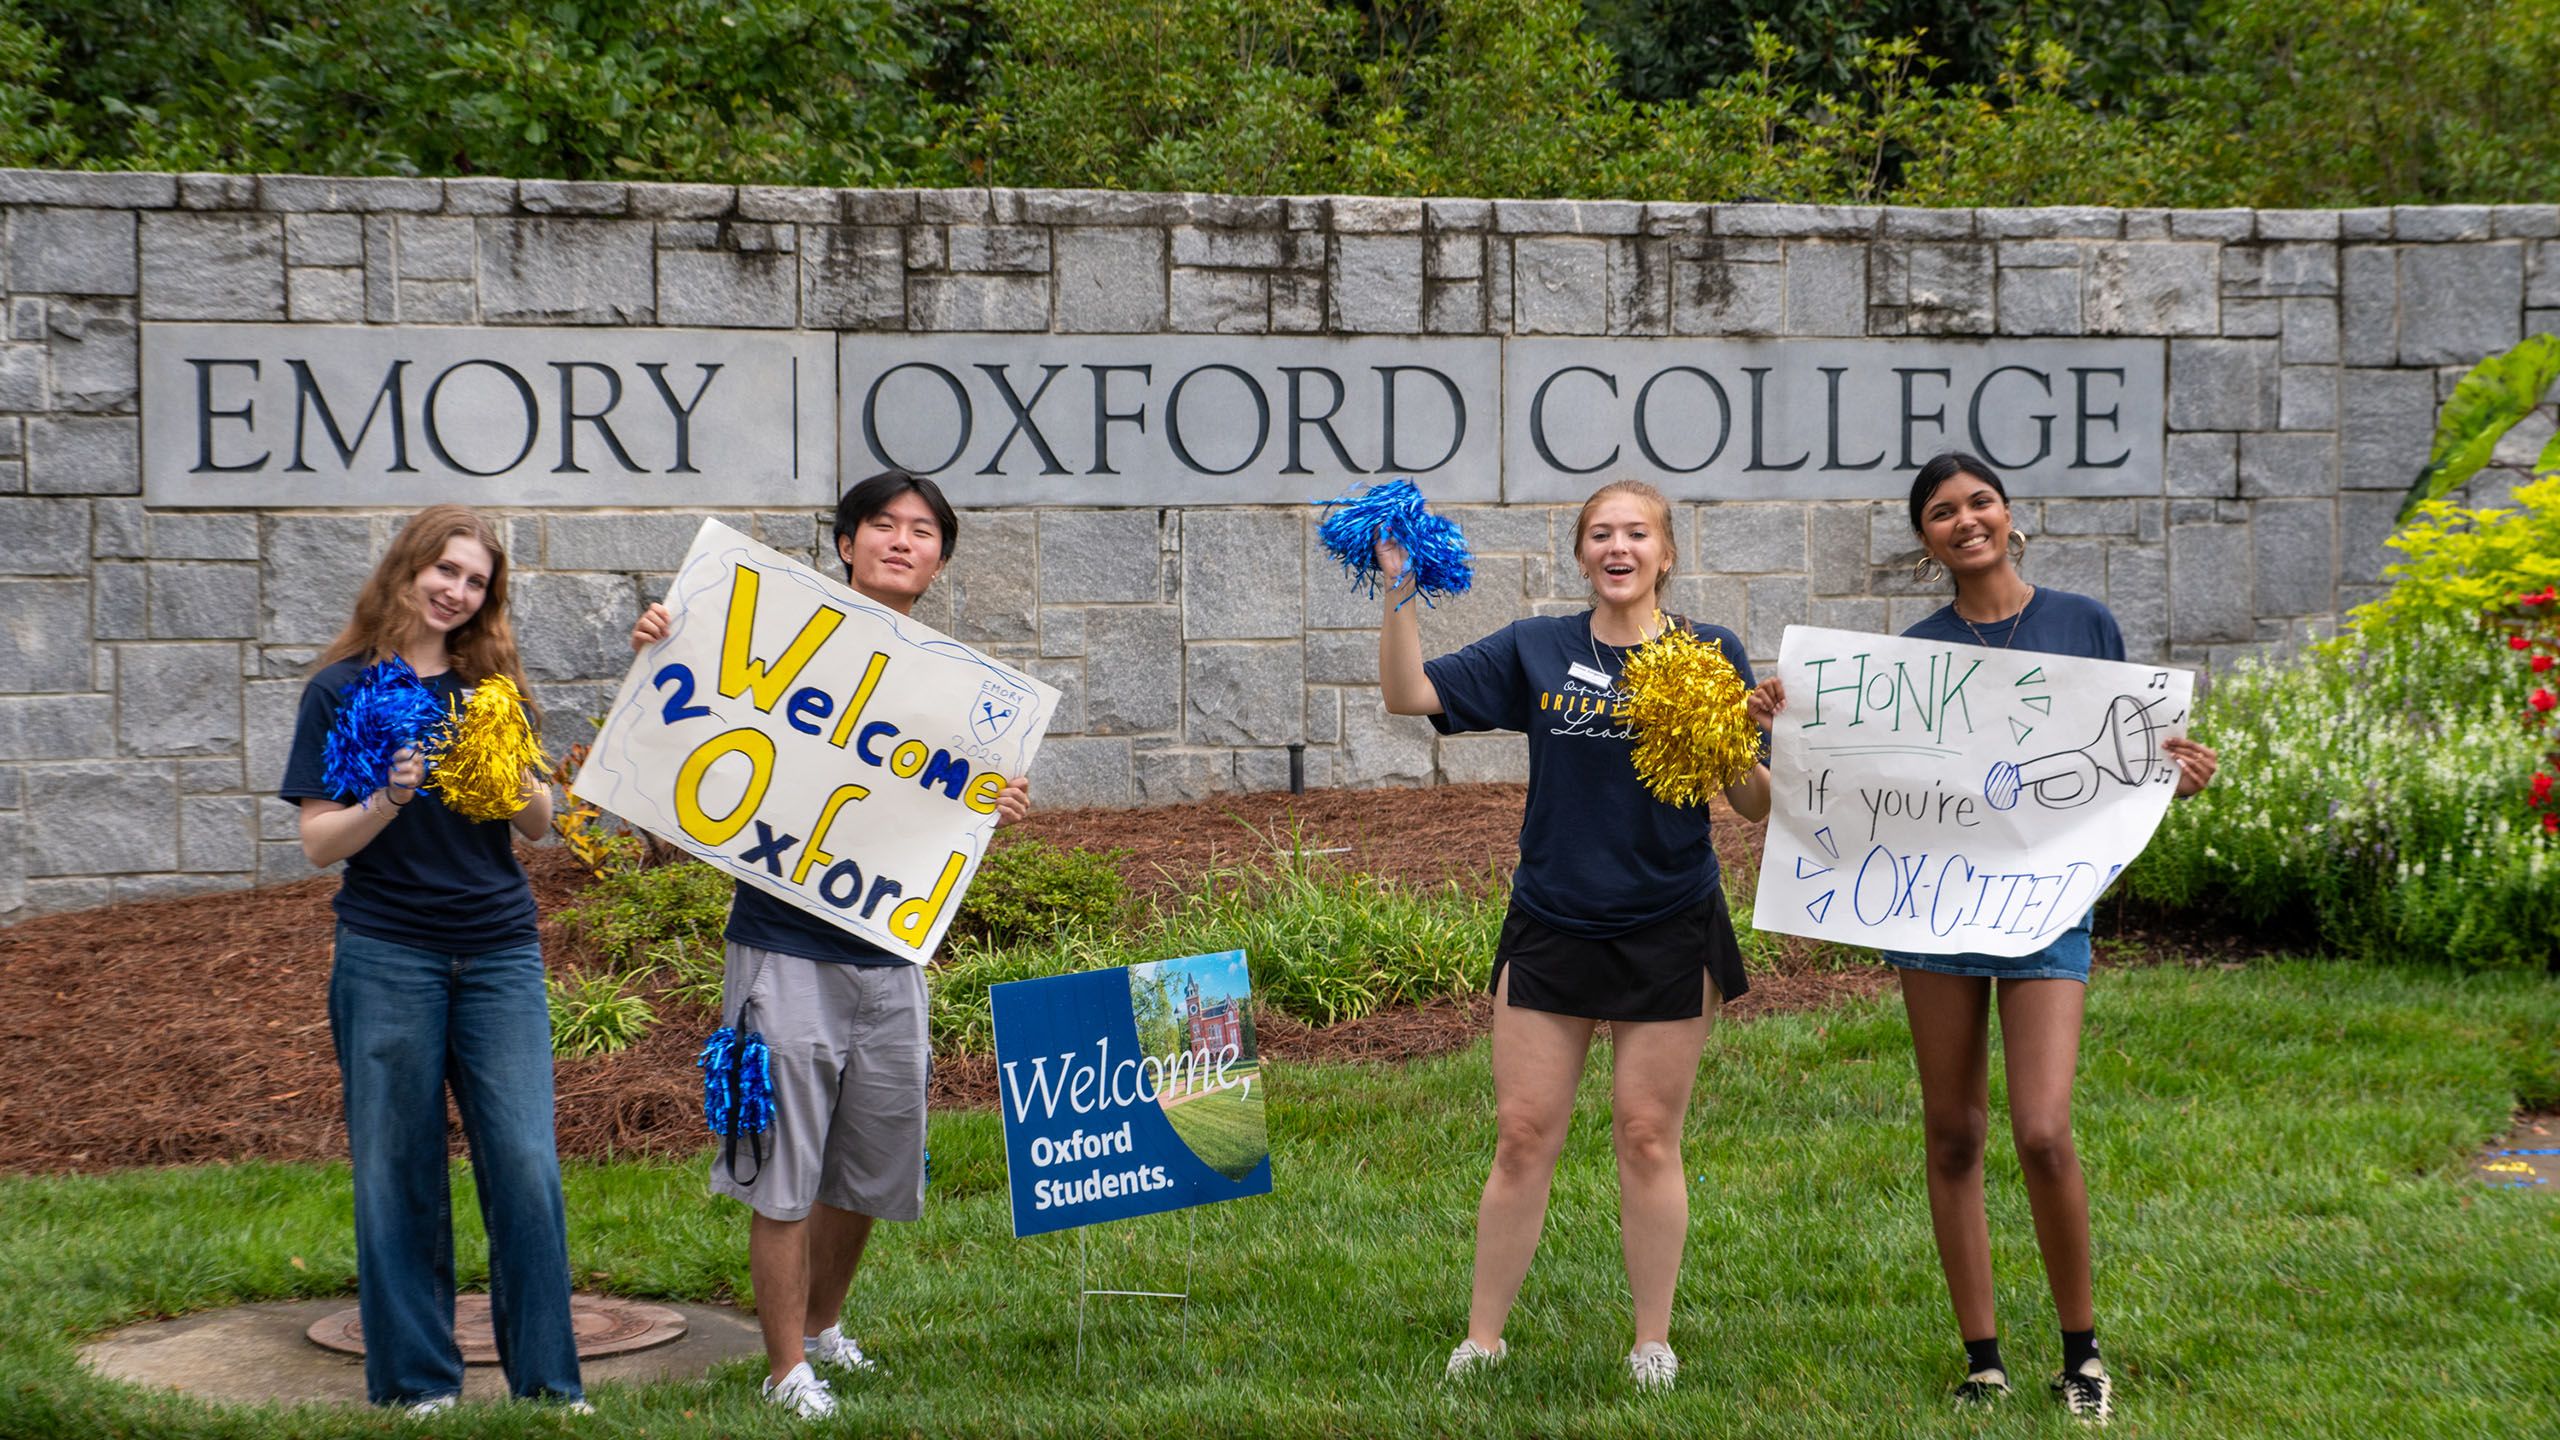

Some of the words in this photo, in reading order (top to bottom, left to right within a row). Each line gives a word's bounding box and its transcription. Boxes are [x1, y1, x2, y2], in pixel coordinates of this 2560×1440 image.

[184, 358, 725, 477] EMORY
[862, 361, 1467, 477] OXFORD
[1529, 364, 2132, 475] COLLEGE
[652, 662, 712, 726] 2
[717, 563, 1008, 816] Welcome
[981, 680, 1024, 704] EMORY
[952, 734, 1003, 770] 2029
[1550, 708, 1642, 740] Lead
[674, 726, 967, 950] Oxford
[1860, 778, 1981, 841] you're
[1002, 1036, 1252, 1124] Welcome,
[1030, 1121, 1133, 1168] Oxford
[1034, 1163, 1175, 1211] Students.
